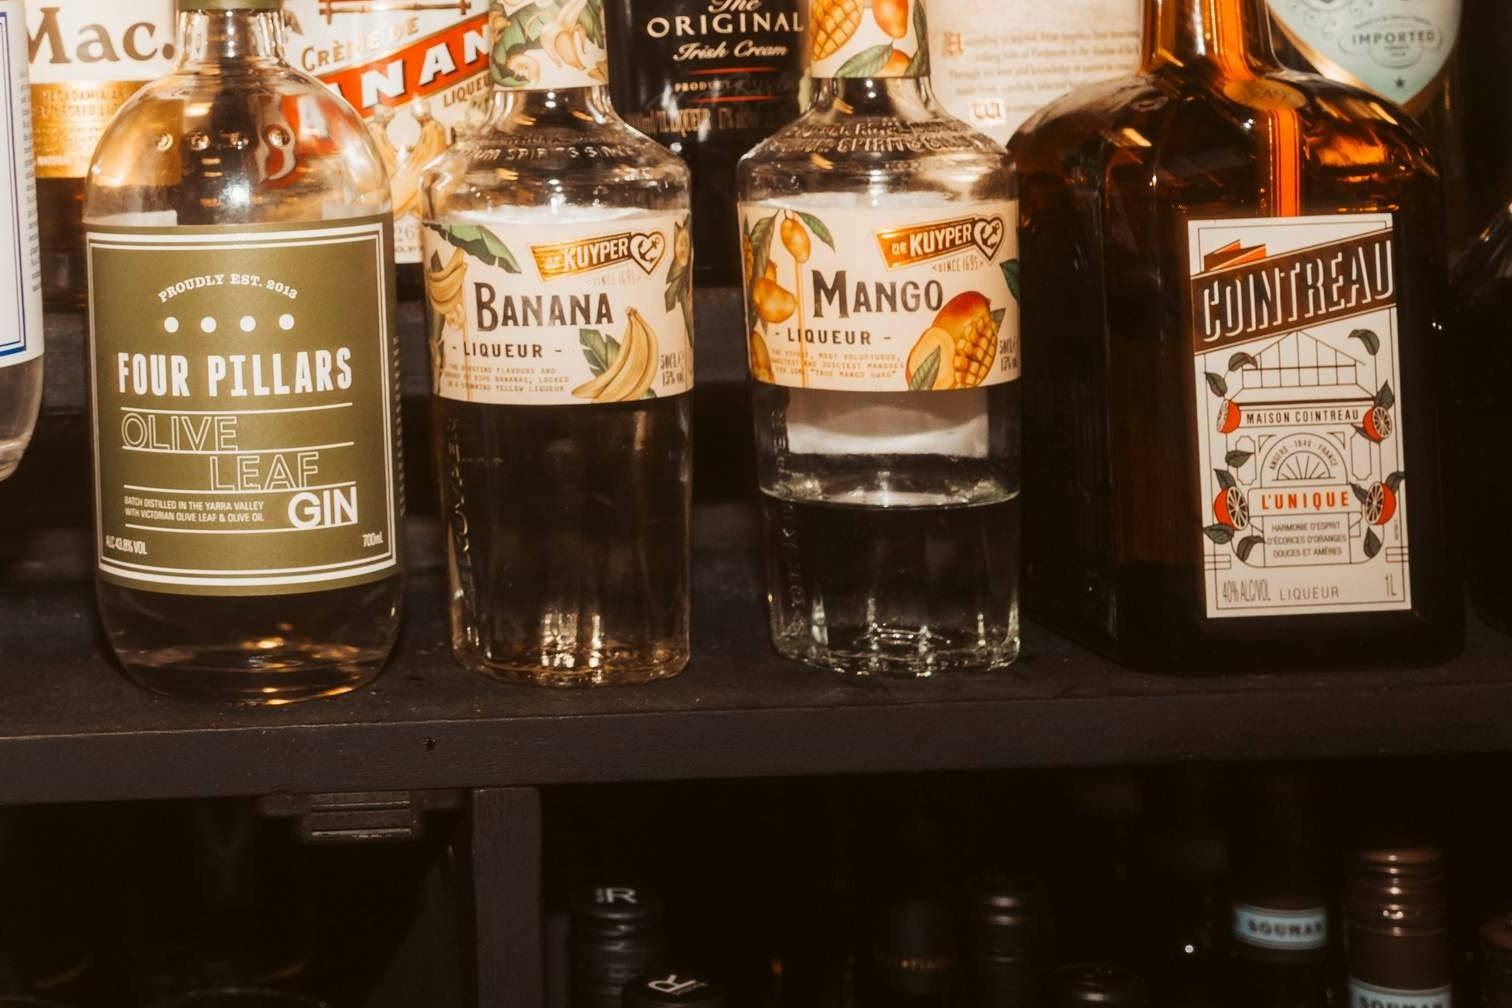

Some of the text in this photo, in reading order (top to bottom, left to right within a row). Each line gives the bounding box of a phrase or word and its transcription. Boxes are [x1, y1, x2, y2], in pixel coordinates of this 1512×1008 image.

[27, 7, 176, 65] Mac.
[646, 12, 805, 39] ORIGINAL
[1351, 29, 1436, 46] IMPORTED
[672, 38, 787, 62] Irish Cream
[563, 236, 629, 274] KUYPER
[909, 222, 973, 258] KUYPER
[157, 273, 299, 304] PROUDLY EST. 2013
[810, 268, 944, 319] MANGO
[1202, 238, 1395, 344] COINTREAU
[473, 281, 615, 333] BANANA
[463, 342, 544, 359] LIQUEUR
[787, 327, 872, 346] LIQUEUR
[117, 346, 354, 398] FOUR PILLARS
[121, 412, 239, 452] OLIVE
[1246, 409, 1360, 425] MAISON COINTREAU
[209, 451, 320, 492] LEAF
[143, 496, 177, 510] DISTILLED
[178, 498, 187, 510] IN
[188, 500, 204, 511] THE
[204, 501, 233, 512] YARRA
[233, 500, 265, 511] VALLEY
[287, 486, 359, 530] GIN
[1261, 491, 1350, 511] L'UNIQUE
[197, 512, 217, 523] LEAF
[218, 512, 226, 523] &
[1279, 585, 1340, 601] LIQUEUR
